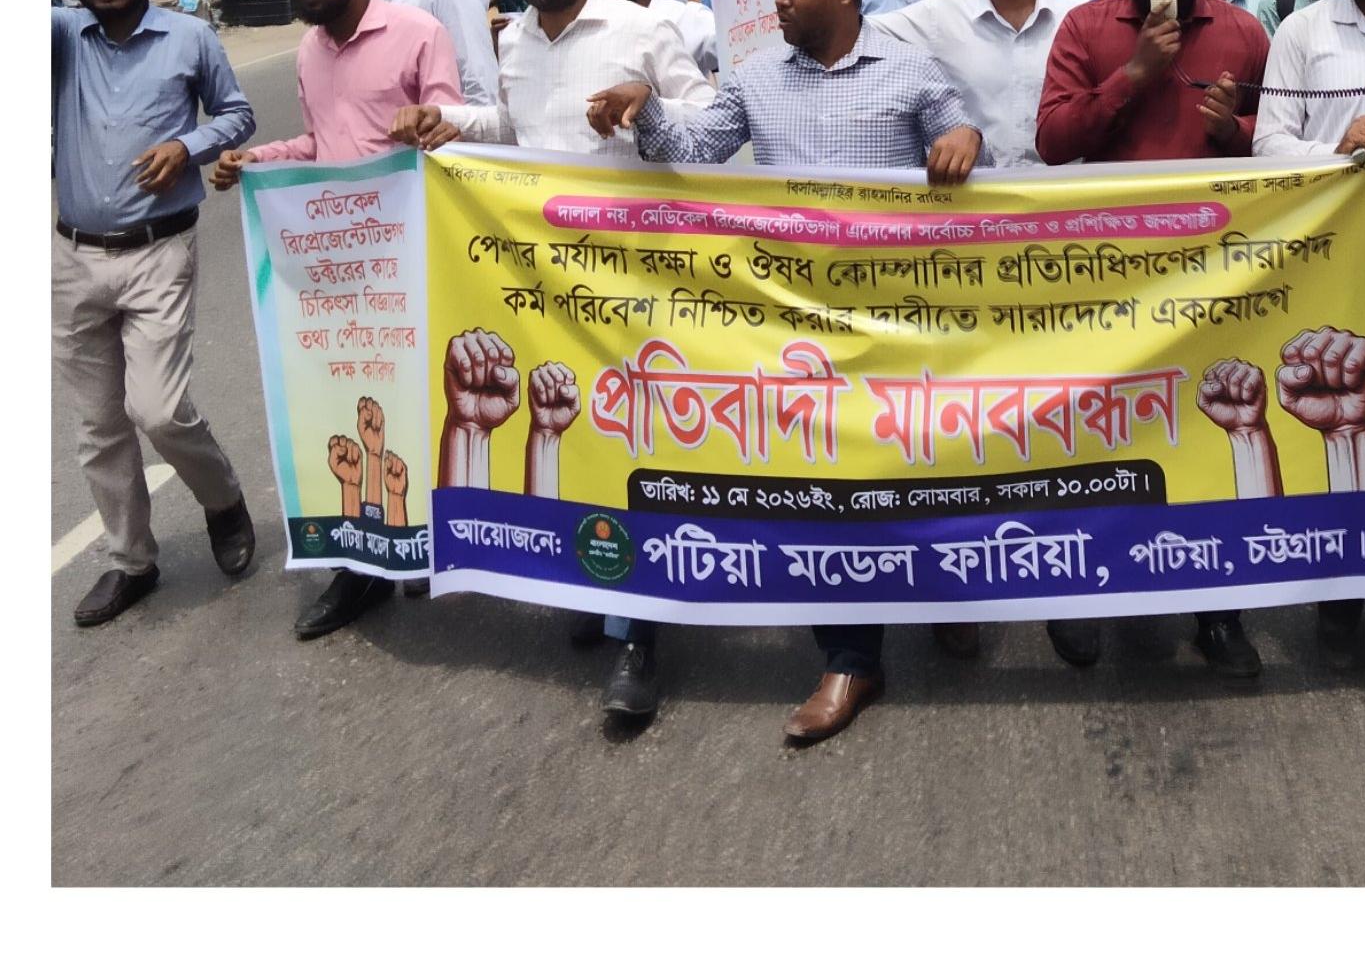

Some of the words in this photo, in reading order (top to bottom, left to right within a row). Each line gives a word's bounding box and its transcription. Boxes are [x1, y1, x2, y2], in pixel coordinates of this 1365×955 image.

[305, 190, 381, 220] মেডিকেল
[917, 191, 952, 204] রাহিম
[557, 204, 601, 226] দালাল
[641, 204, 708, 228] মেডিকেল
[711, 207, 840, 241] রিপ্রেজেন্টেটিভগণ
[846, 220, 912, 241] এদেশের
[917, 218, 976, 240] সর্বোচ্চ
[980, 218, 1039, 239] শিক্ষিত
[1045, 221, 1060, 235] ও
[1064, 214, 1138, 236] প্রশিক্ষিত
[305, 258, 365, 284] ডক্টরের
[370, 257, 398, 278] কাছে
[468, 234, 538, 269] পেশার
[548, 234, 629, 275] মর্যাদা
[637, 248, 698, 278] রক্ষা
[709, 253, 732, 279] ও
[747, 241, 814, 286] ঔষধ
[826, 247, 987, 289] কোম্পানির
[997, 242, 1210, 287] প্রতিনিধিগণের
[299, 290, 358, 318] চিকিৎসা
[501, 281, 546, 319] কর্ম
[553, 284, 658, 326] পরিবেশ
[670, 287, 767, 328] নিশ্চিত
[774, 303, 856, 335] করার
[866, 295, 980, 336] দাবীতে
[988, 295, 1141, 336] সারাদেশে
[1151, 282, 1293, 330] একযোগে
[296, 327, 329, 350] তথ্য
[336, 320, 374, 349] পৌঁছে
[328, 361, 357, 383] দক্ষ
[592, 339, 850, 464] প্রতিবাদী
[865, 367, 1188, 465] মানববন্ধন
[640, 477, 695, 503] তারিখ:
[701, 487, 720, 505] ১১
[728, 486, 749, 507] মে
[754, 484, 845, 513] ২০২৬ইং,
[850, 491, 900, 510] রোজ:
[908, 487, 991, 506] সোমবার,
[996, 477, 1050, 500] সকাল
[330, 521, 363, 552] পটিয়া
[366, 531, 389, 559] মডেল
[448, 518, 562, 557] আয়োজনে:
[642, 523, 768, 588] পটিয়া
[780, 541, 919, 587] মডেল
[931, 522, 1110, 587] ফারিয়া,
[1128, 531, 1234, 576] পটিয়া,
